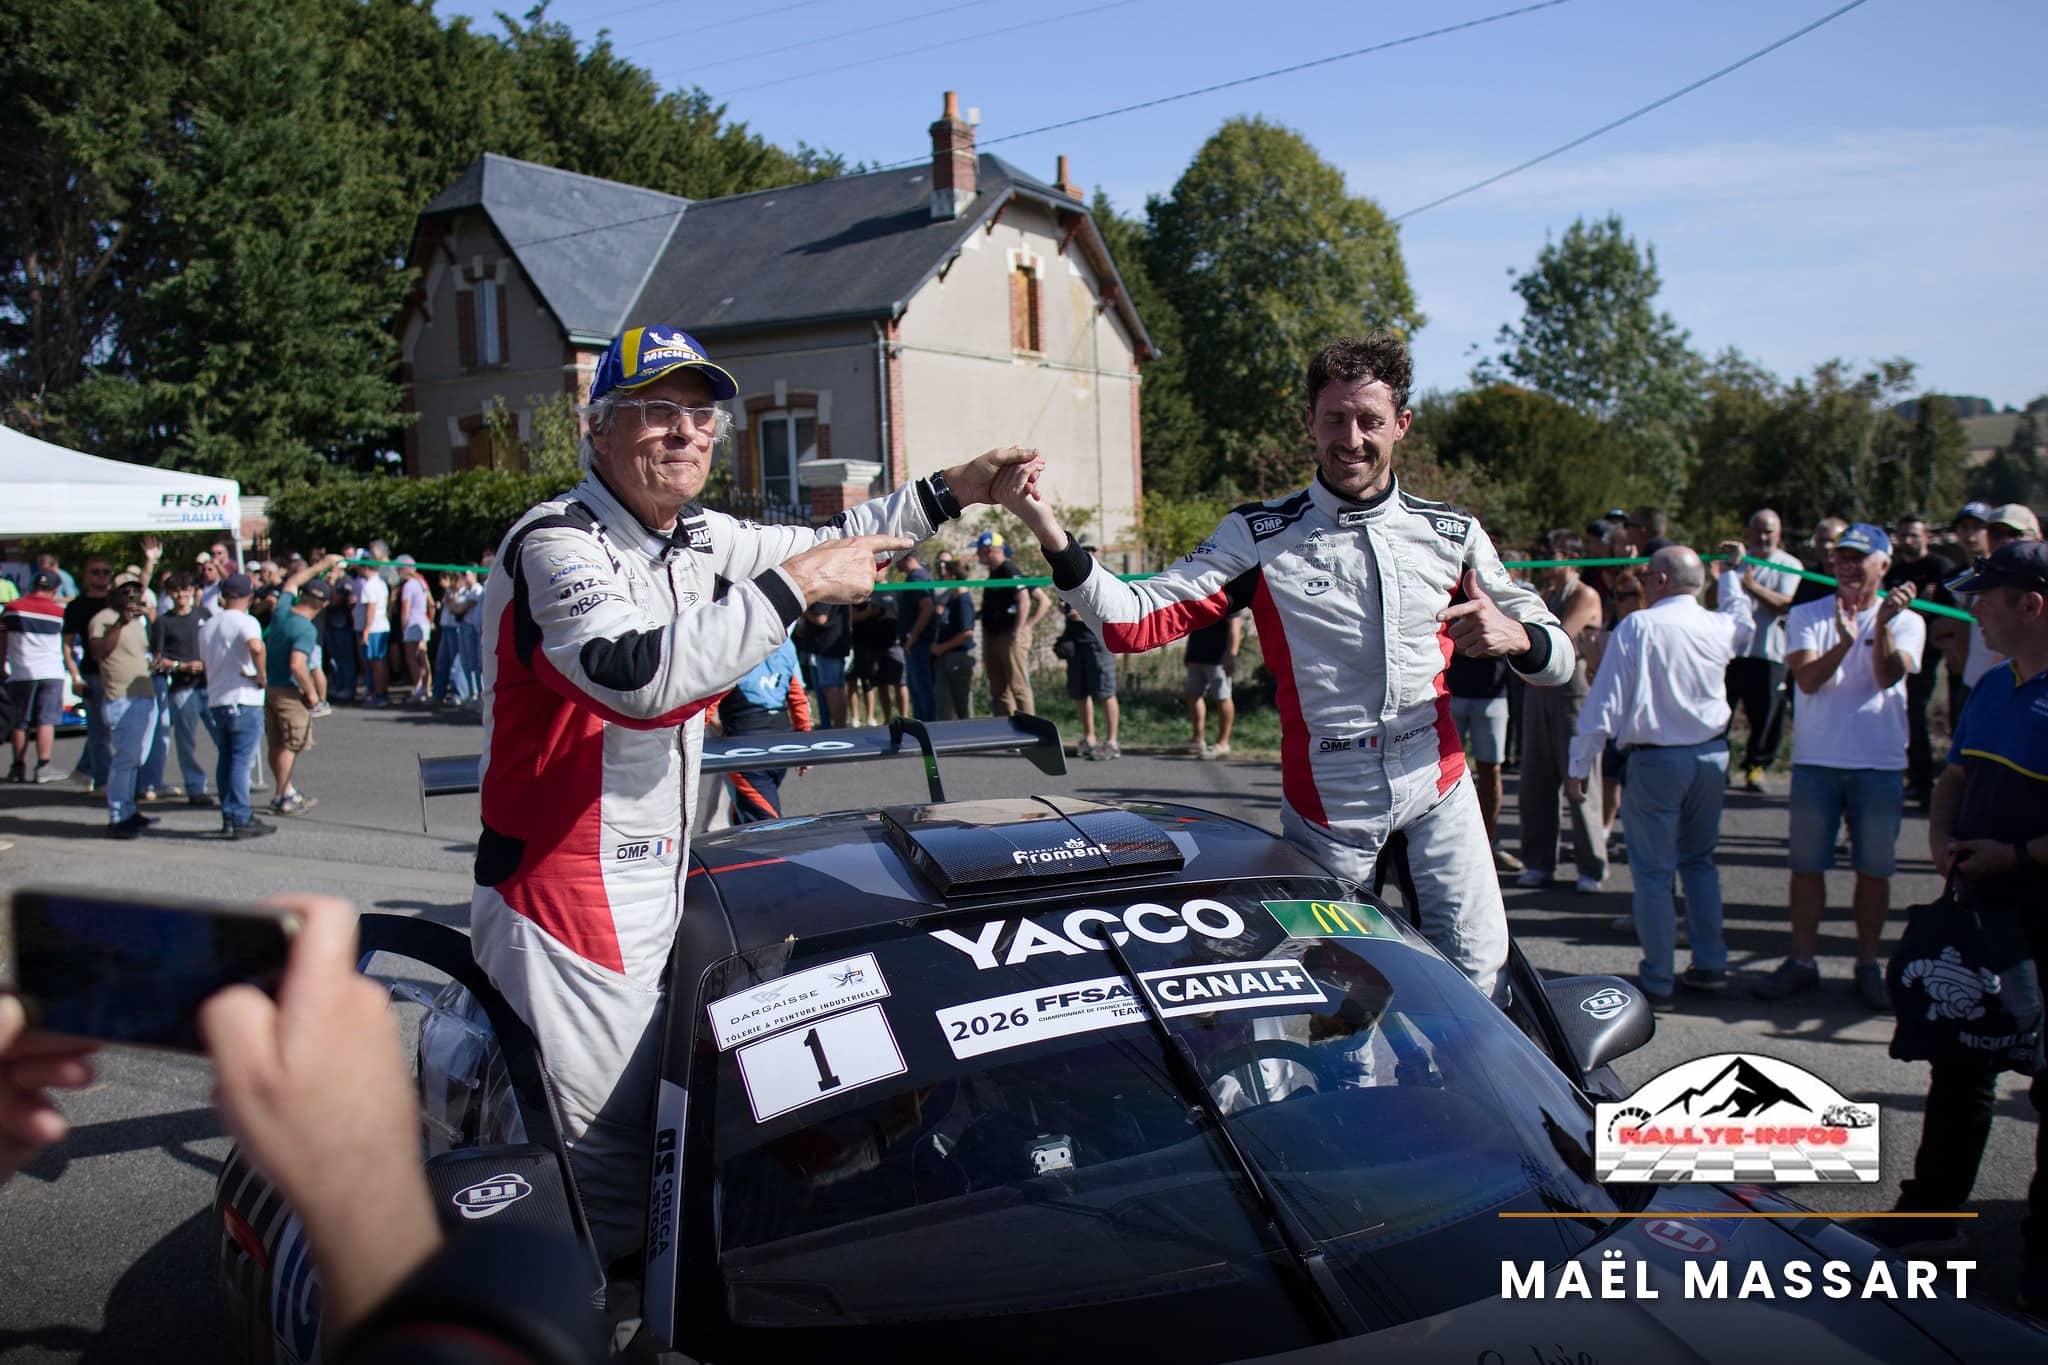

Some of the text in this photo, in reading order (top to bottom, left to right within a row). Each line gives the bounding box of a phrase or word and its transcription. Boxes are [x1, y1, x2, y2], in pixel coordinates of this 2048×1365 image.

[161, 493, 219, 508] FFSA
[1253, 517, 1284, 532] OMP
[1436, 520, 1466, 534] OMP
[549, 563, 602, 585] MICHELIN
[617, 844, 649, 860] OMP
[1012, 843, 1111, 865] Froment
[928, 899, 1246, 970] YACCO
[1035, 984, 1134, 1013] FFSA
[1157, 970, 1305, 1002] CANAL+
[730, 989, 819, 1025] DARGAISSE
[774, 1006, 817, 1025] PEINTURE
[820, 988, 881, 1010] INDUSTRIELLE
[1038, 1009, 1085, 1022] CHAMPIONNAT
[1096, 1003, 1121, 1012] FRANCE
[951, 1007, 1029, 1042] 2026
[803, 1027, 842, 1092] 1
[657, 1178, 674, 1257] ORECA
